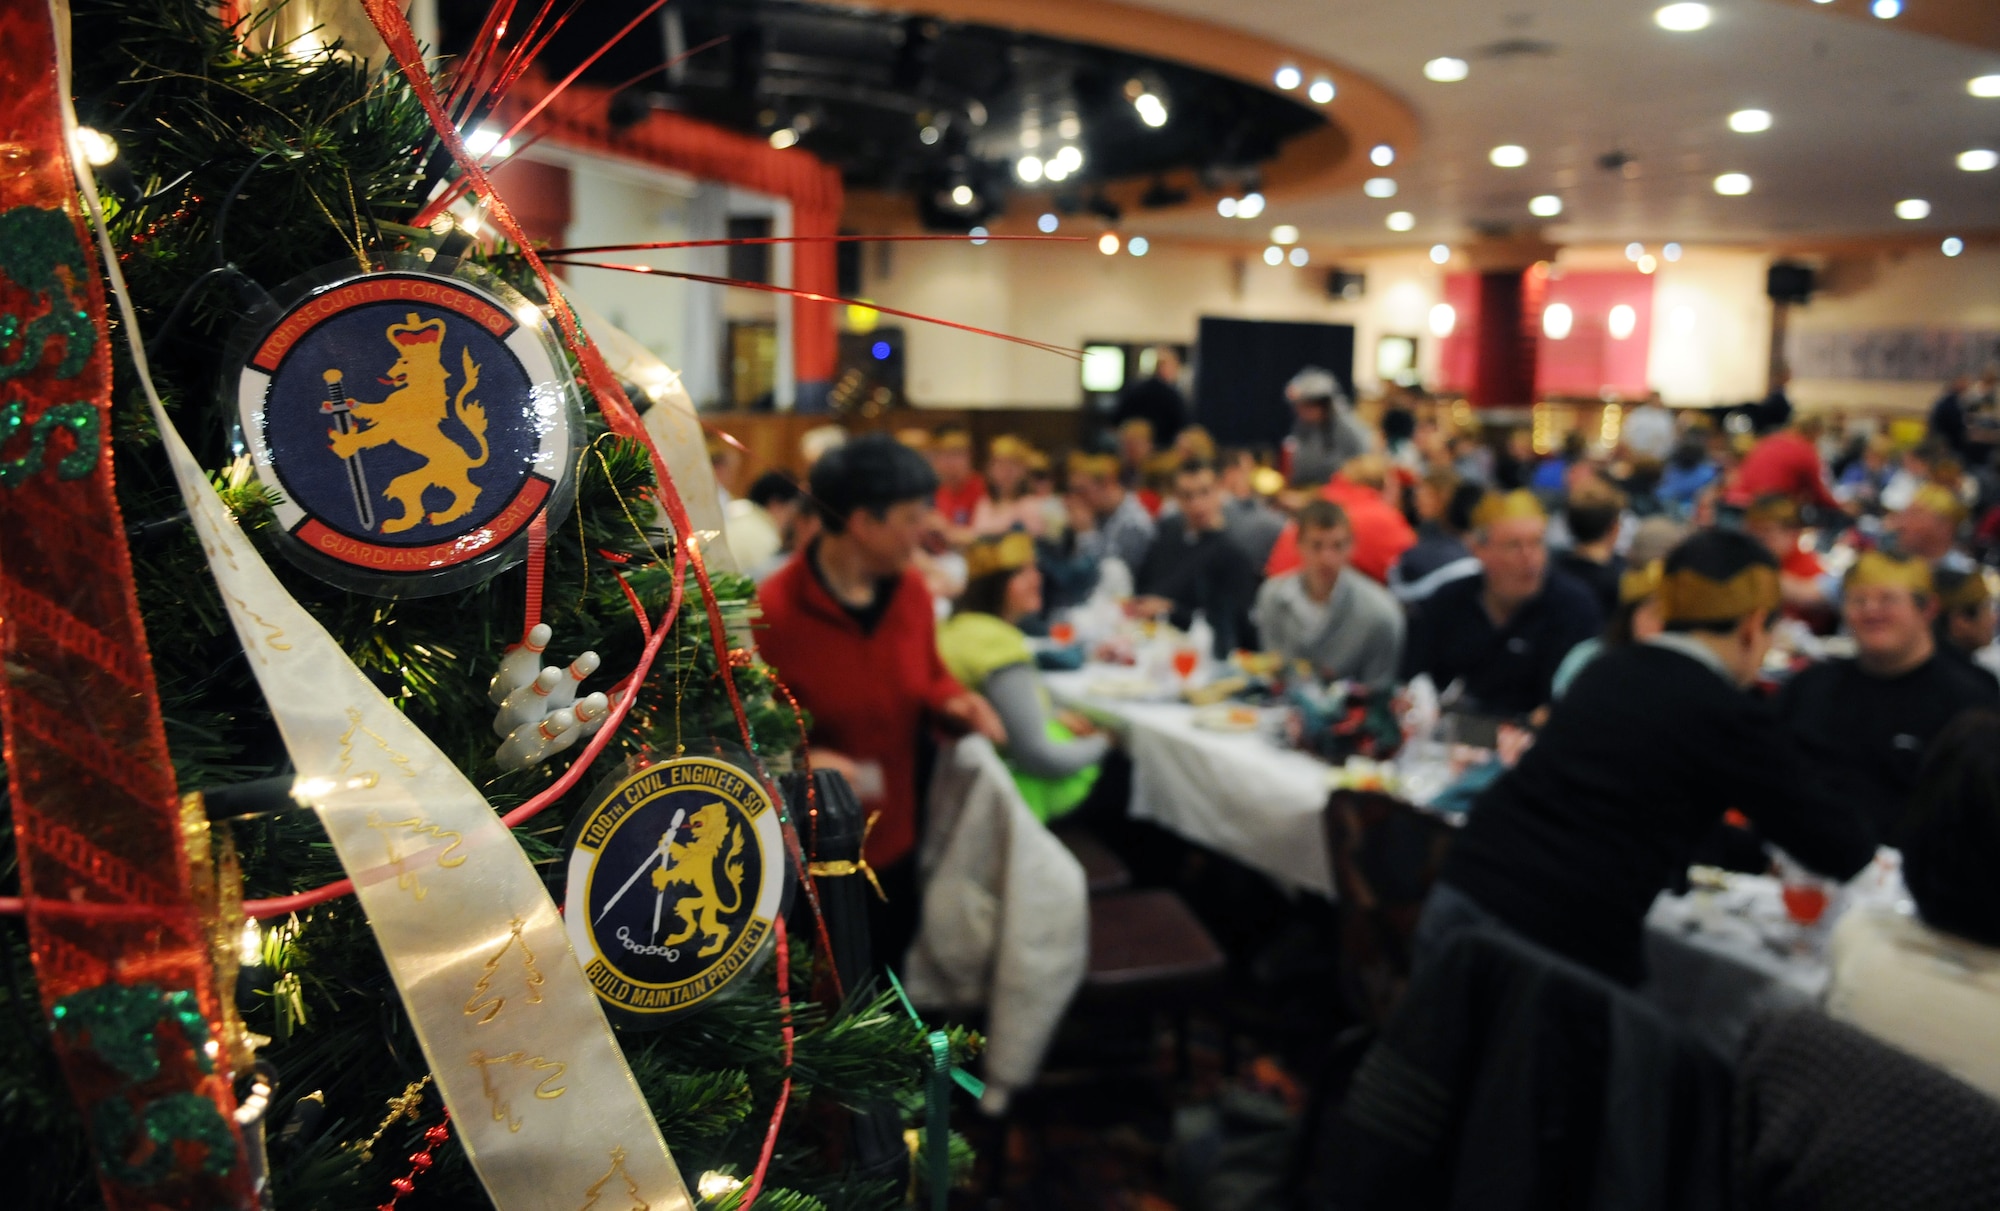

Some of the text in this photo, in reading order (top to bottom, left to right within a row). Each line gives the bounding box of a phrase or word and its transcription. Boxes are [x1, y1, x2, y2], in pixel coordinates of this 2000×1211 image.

[261, 283, 504, 360] 100th SECURITY FORCES SQ
[320, 534, 430, 565] GUARDIANS
[496, 495, 534, 532] GATE
[586, 766, 763, 844] 100TH CIVIL ENGINEER SQ
[588, 921, 767, 1006] BUILD MAINTAIN PROTECT
